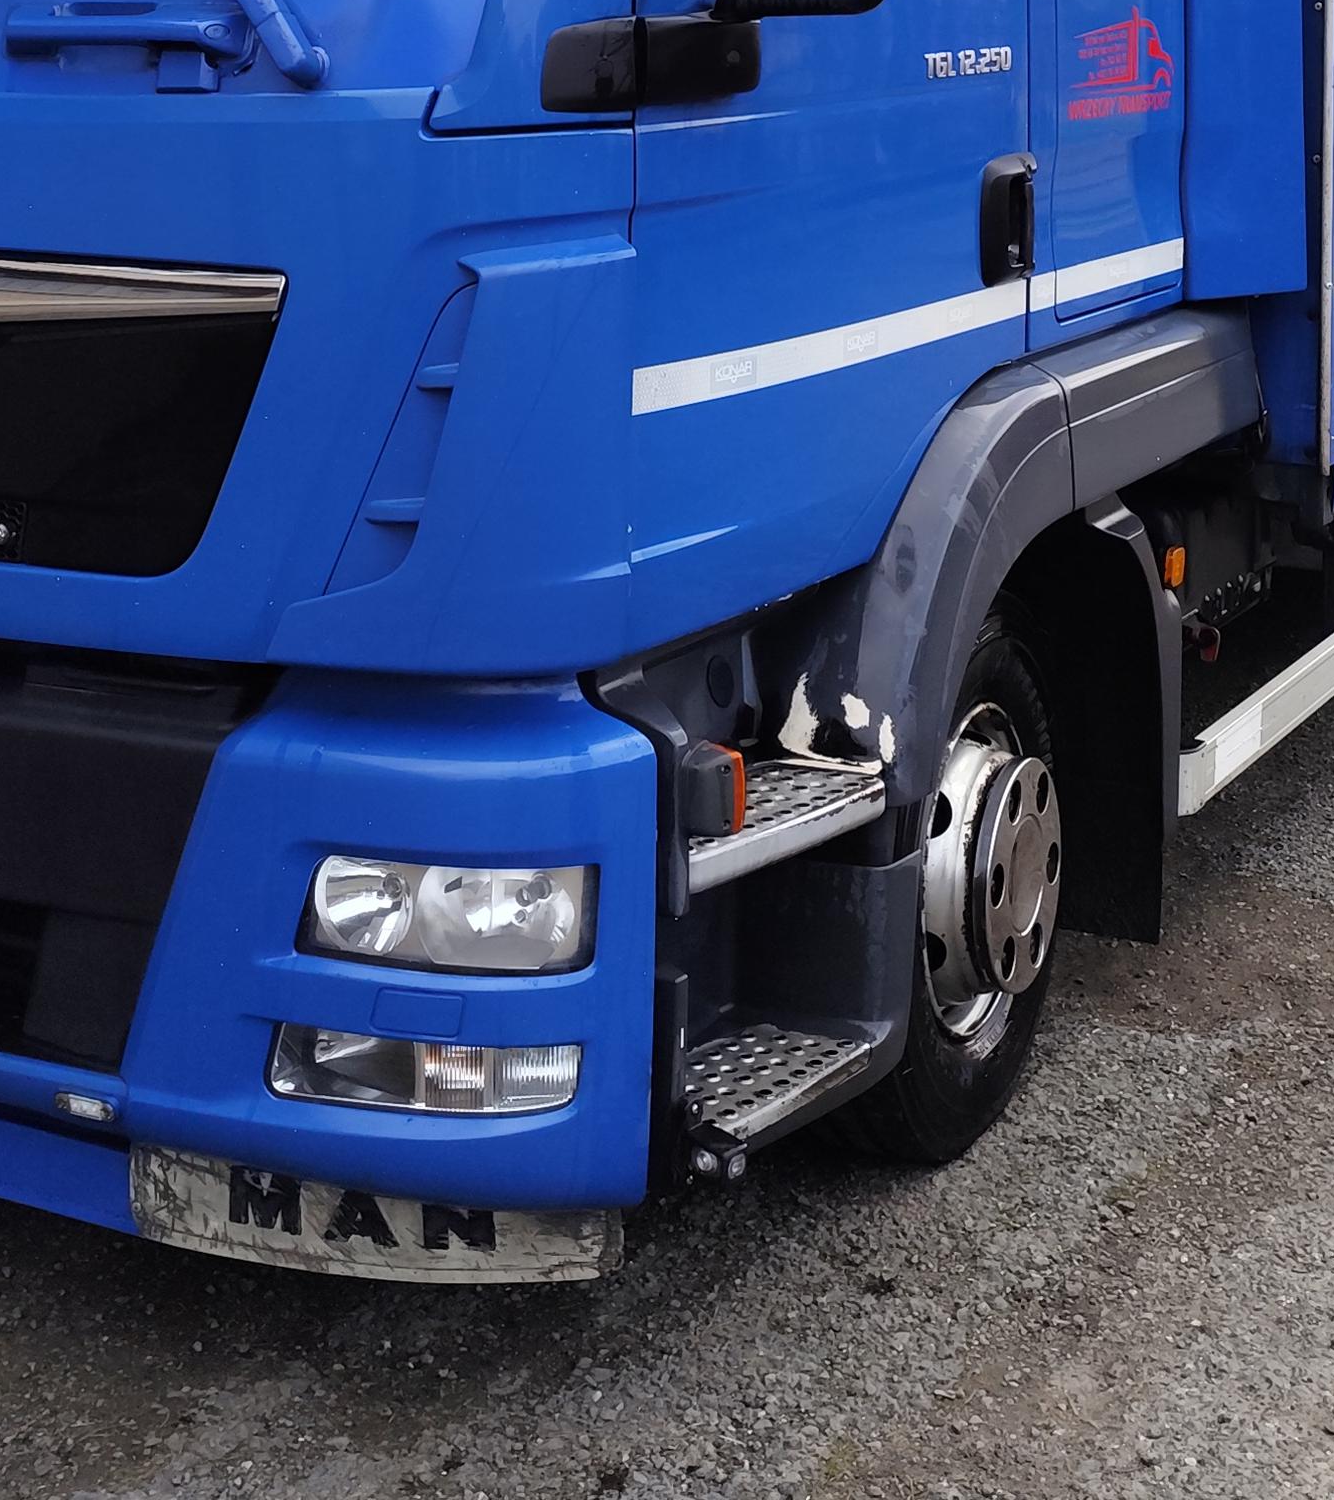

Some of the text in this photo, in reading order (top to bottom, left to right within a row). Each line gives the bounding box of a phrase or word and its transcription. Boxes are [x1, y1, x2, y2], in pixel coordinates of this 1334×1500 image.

[924, 46, 1012, 79] TGL 12.250
[229, 1165, 496, 1252] MAN
